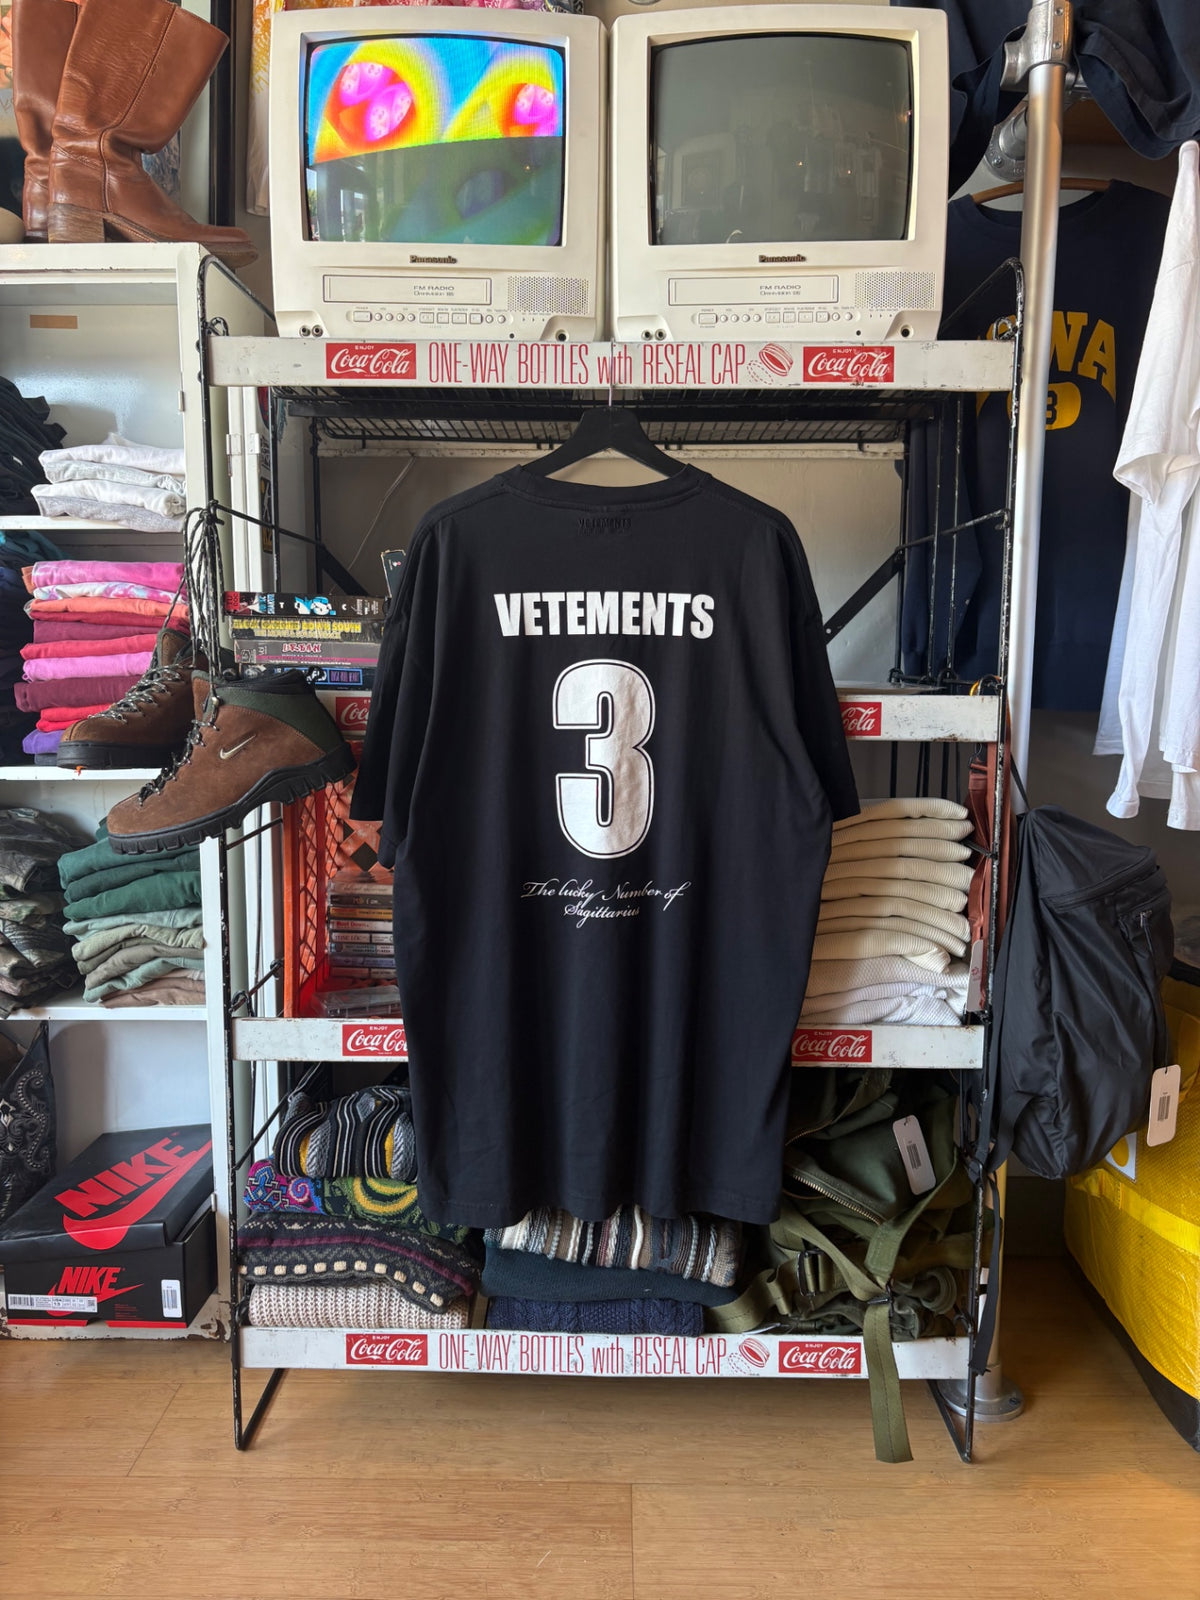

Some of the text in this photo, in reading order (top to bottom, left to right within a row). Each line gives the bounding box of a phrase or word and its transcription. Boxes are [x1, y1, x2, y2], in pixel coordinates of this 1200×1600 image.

[409, 254, 458, 264] Panasonic
[758, 254, 807, 263] Panasonic
[331, 348, 413, 375] Coca-Cola
[429, 342, 746, 385] ONE-WAY BOTTLES with RESEAL CAP
[808, 352, 891, 378] Coca-Cola
[493, 591, 715, 640] VETEMENTS
[552, 658, 656, 860] 3
[520, 878, 692, 912] The lucky Number of
[564, 902, 640, 929] Sagittarius
[792, 1034, 869, 1058] Coca-Cola
[54, 1137, 195, 1218] NIKE
[57, 1266, 121, 1295] NIKE
[350, 1338, 424, 1361] Coca-Cola
[439, 1333, 727, 1375] ONE-WAY BOTTLES with RESEAL CAP
[782, 1346, 858, 1370] Coca-Cola
